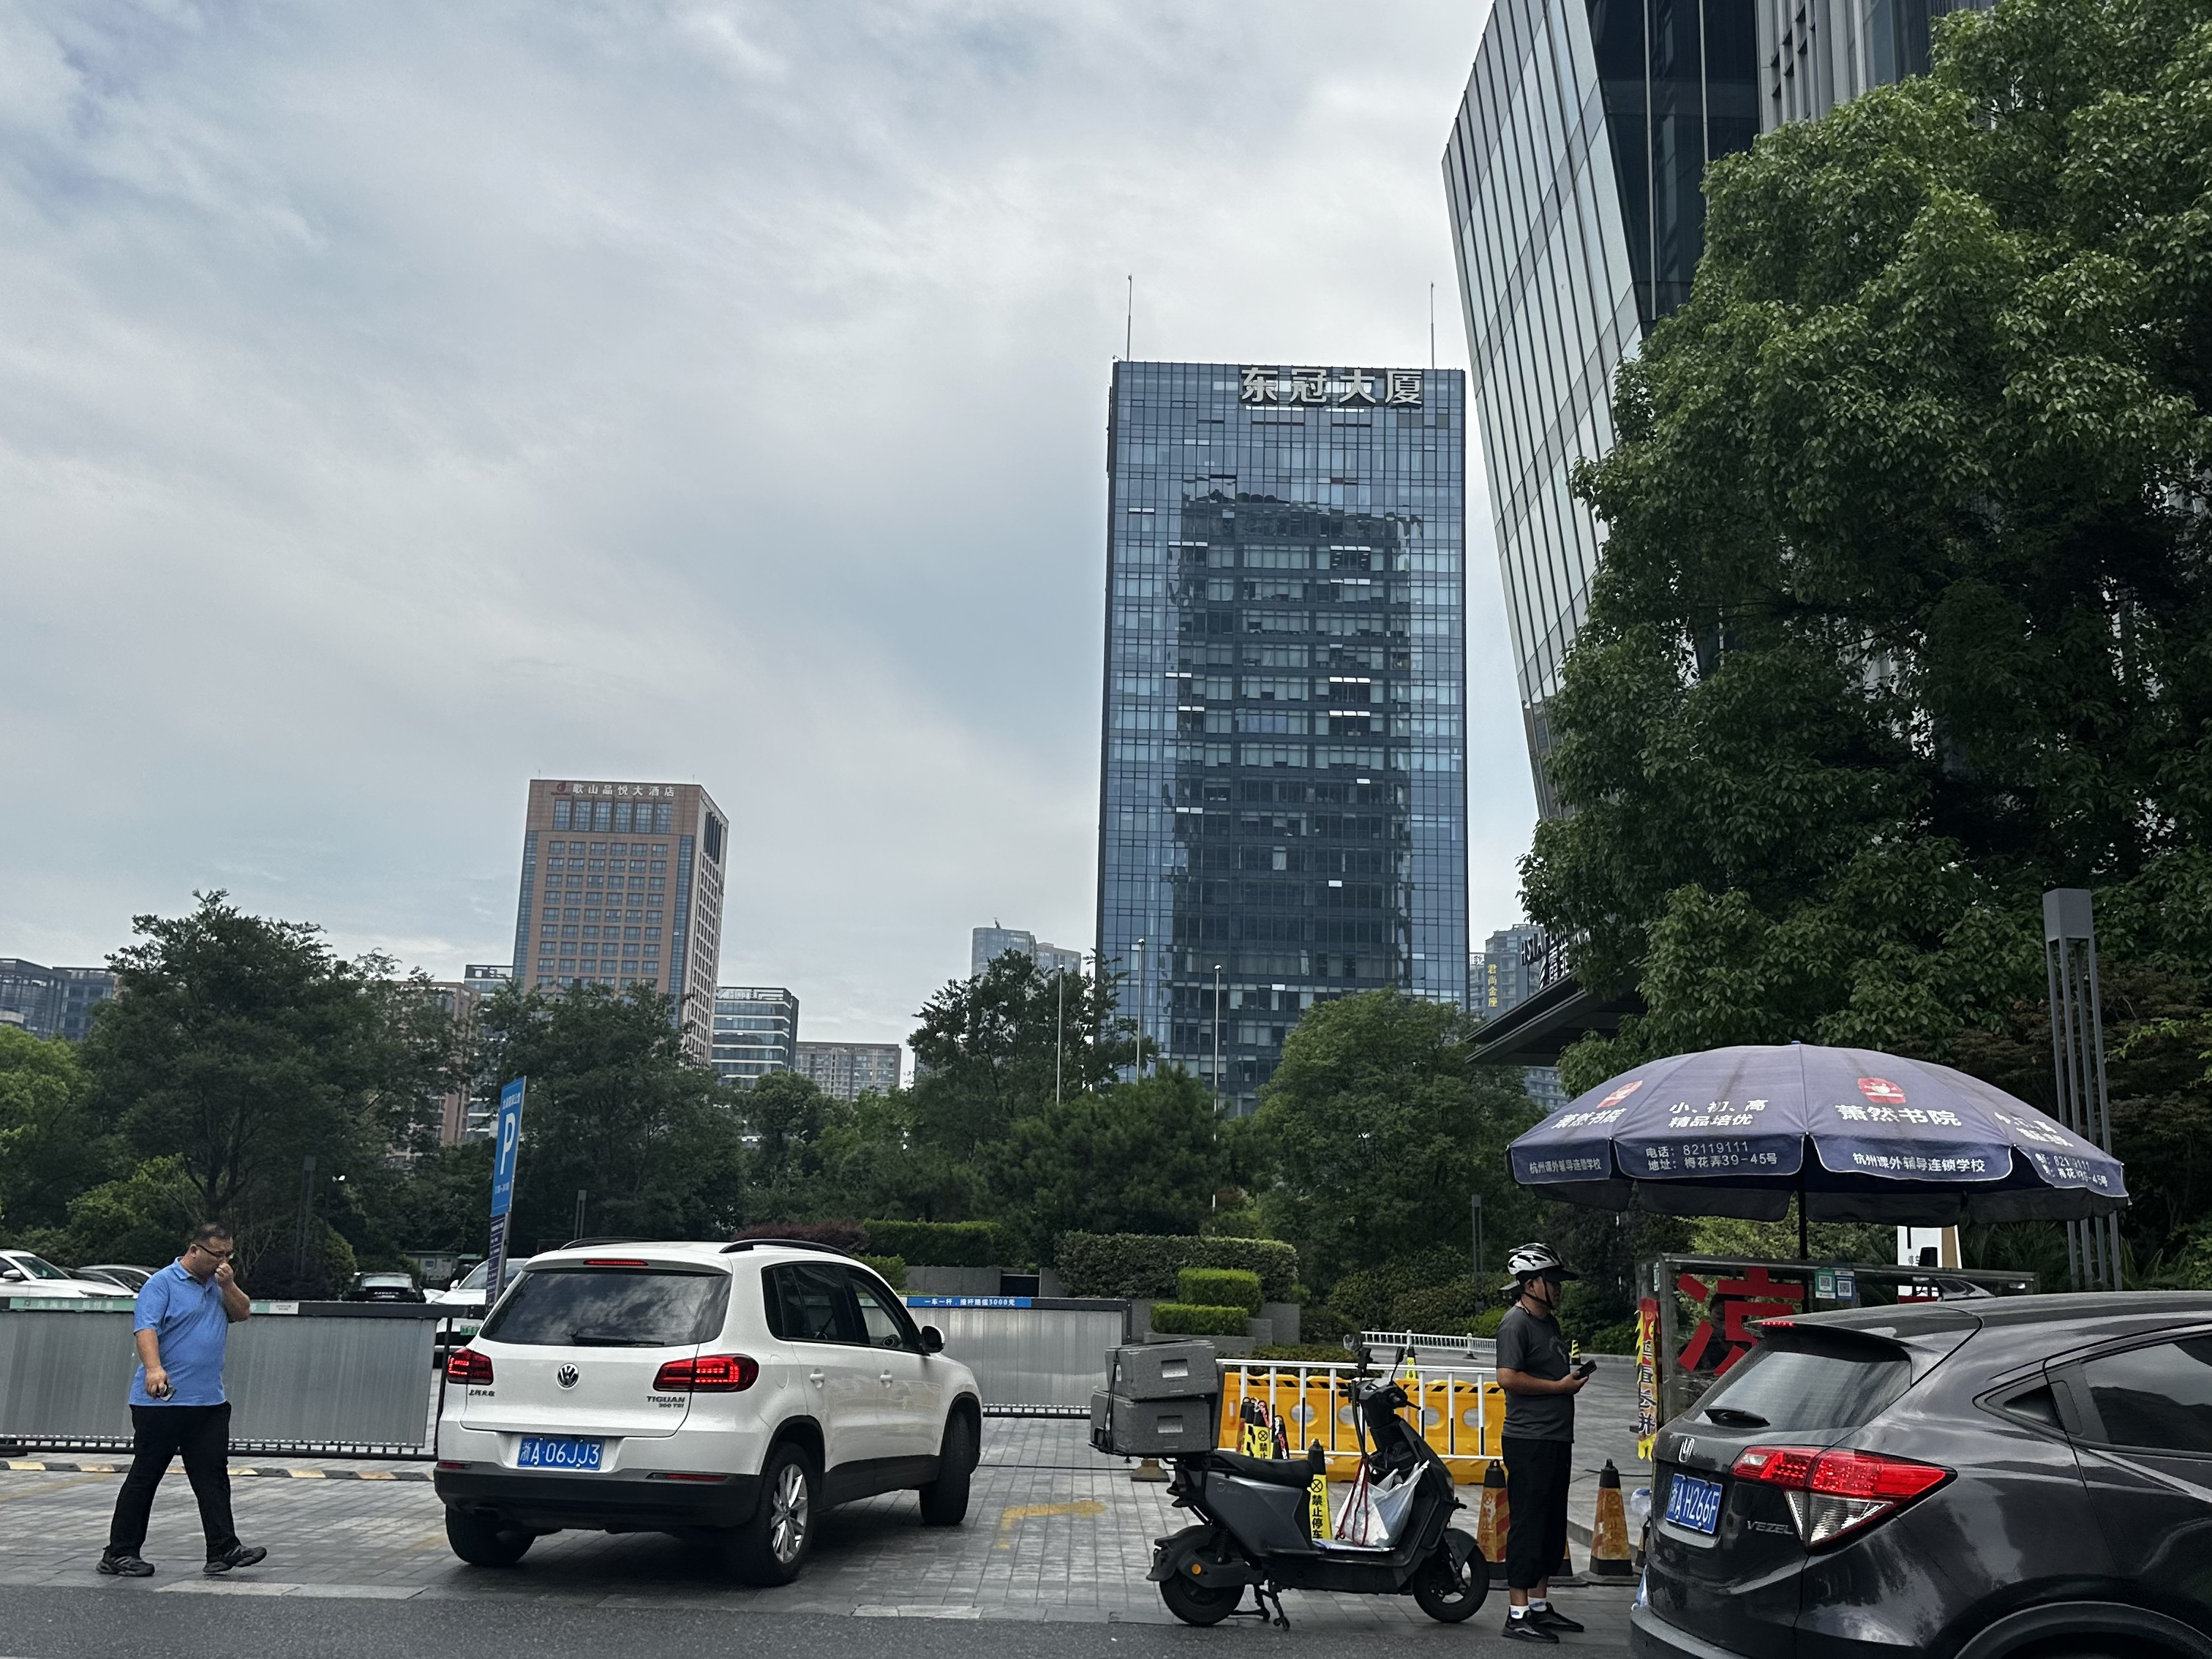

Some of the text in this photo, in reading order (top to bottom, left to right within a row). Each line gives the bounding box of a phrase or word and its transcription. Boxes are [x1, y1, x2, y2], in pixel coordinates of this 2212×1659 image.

[1241, 367, 1422, 405] 东冠大厦
[572, 783, 675, 797] 歌山品悦大酒店
[1669, 1114, 1753, 1128] 精品培优
[1835, 1105, 1962, 1126] 萧然书院
[500, 1112, 516, 1175] P
[1312, 1495, 1323, 1539] 禁止停车
[1747, 1520, 1794, 1535] VEZEL
